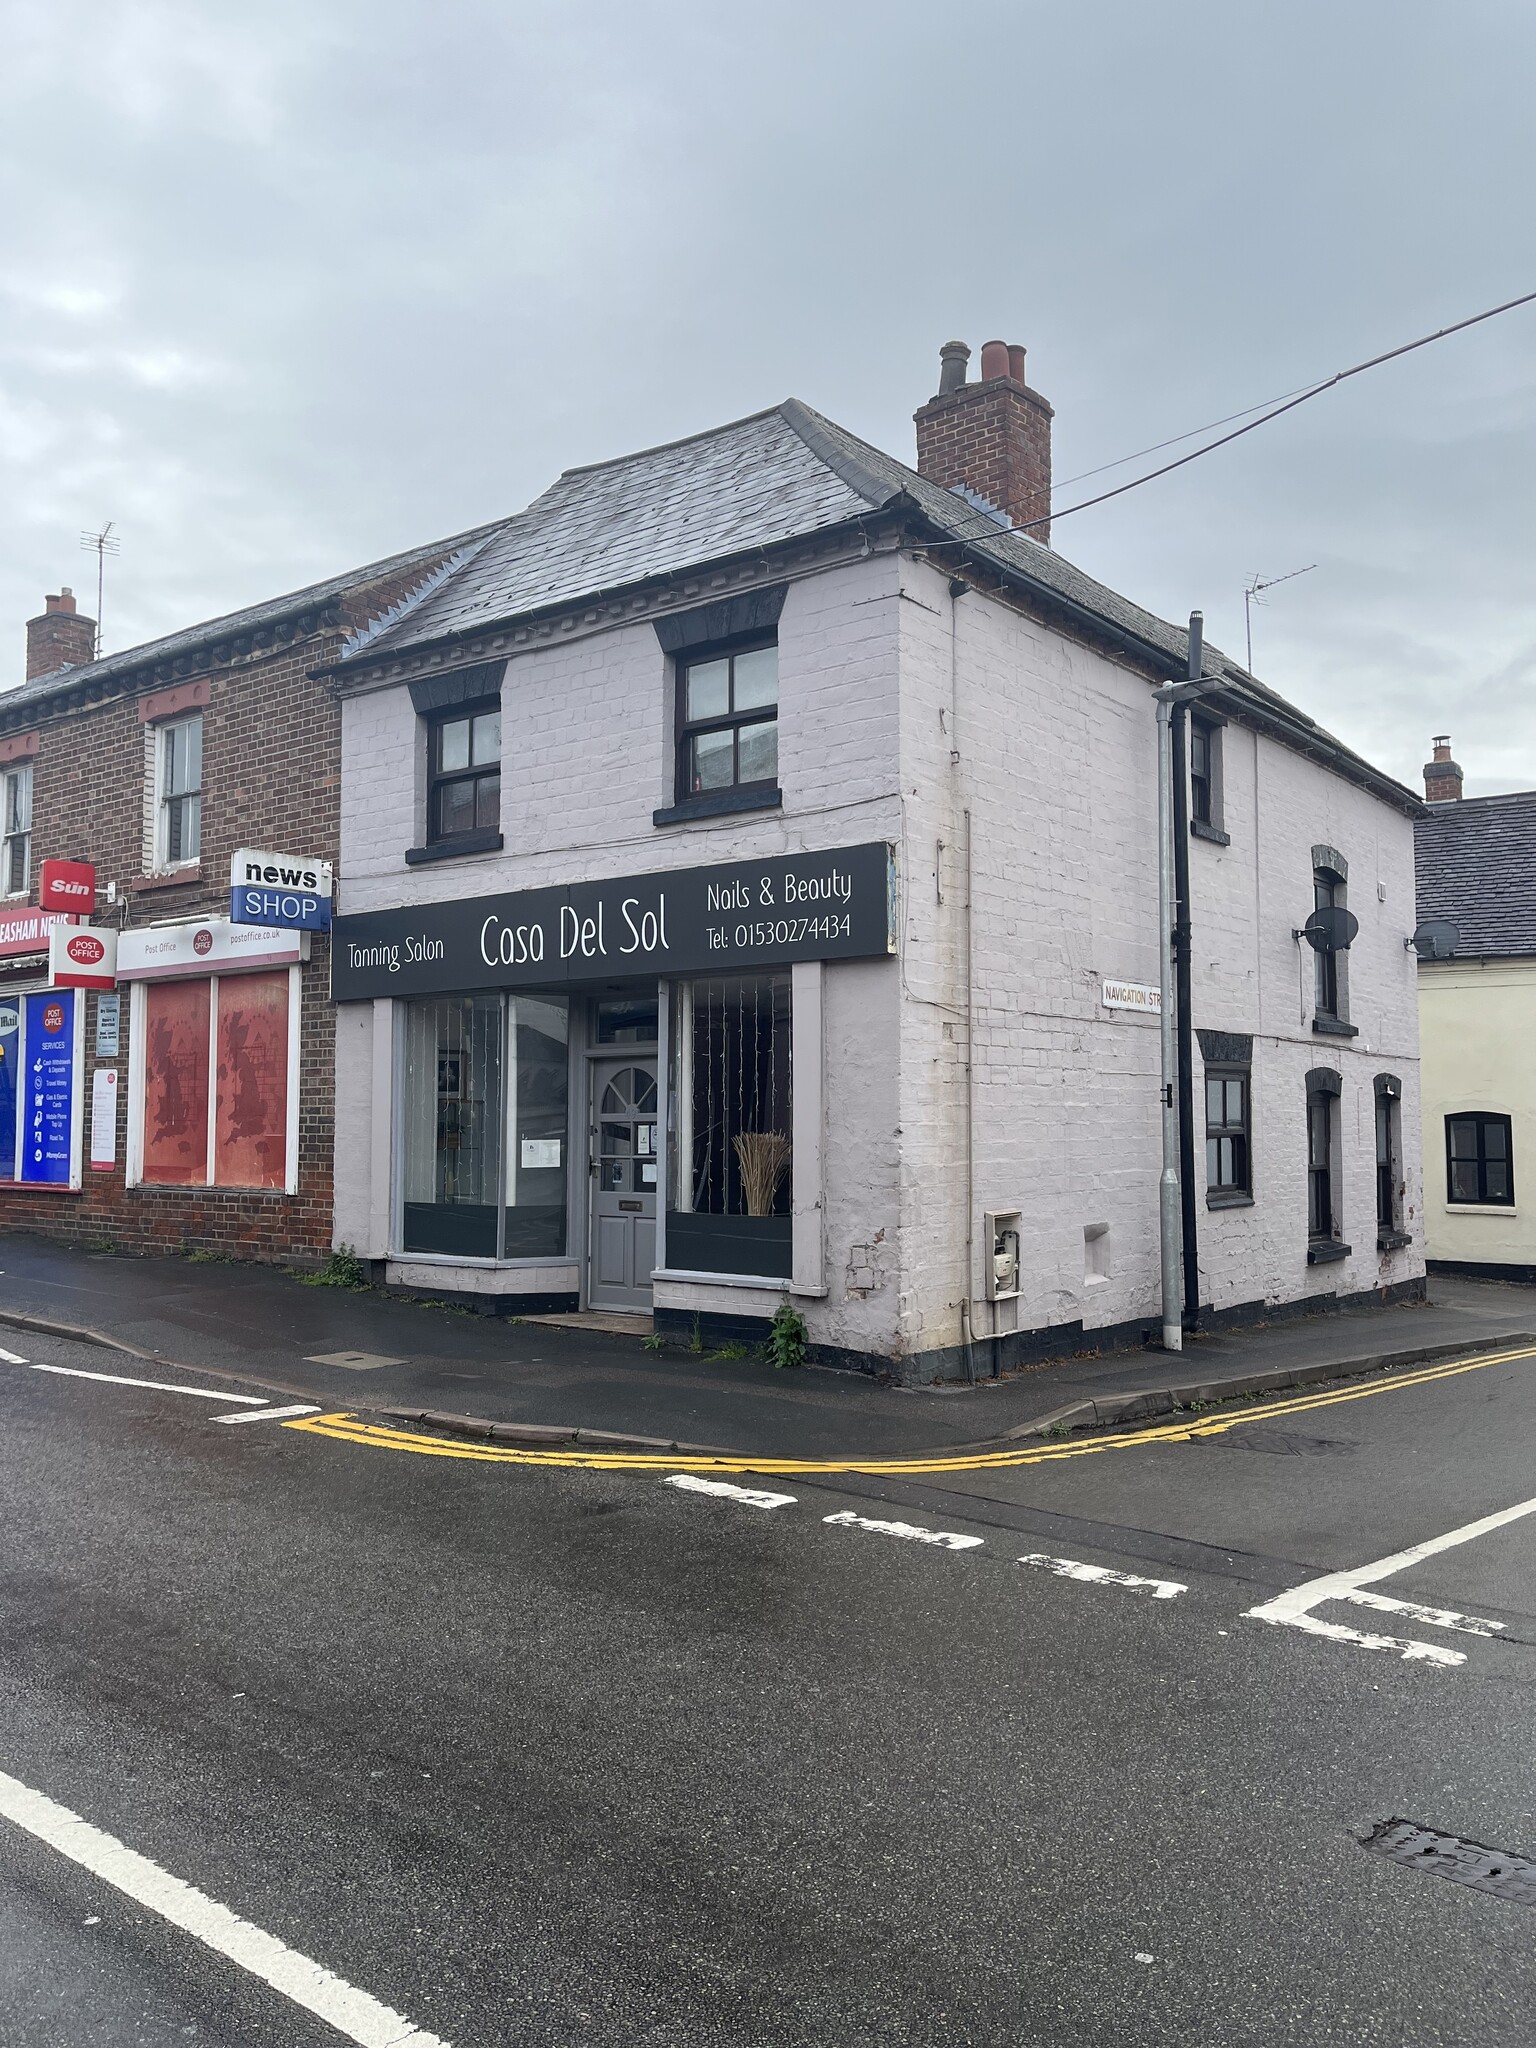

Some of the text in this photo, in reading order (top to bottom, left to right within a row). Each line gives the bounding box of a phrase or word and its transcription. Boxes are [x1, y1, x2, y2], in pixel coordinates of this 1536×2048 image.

[246, 863, 317, 889] news
[50, 879, 90, 895] Sun
[707, 868, 852, 913] Nails & Beauty
[245, 892, 317, 920] SHOP
[0, 918, 38, 944] EASHAM
[230, 928, 280, 945] postoffice.co.uk
[481, 892, 670, 967] Casa Del Sol
[705, 914, 850, 950] Tel: 01530274434
[75, 940, 98, 949] POST
[195, 941, 211, 950] OFFICE
[197, 934, 210, 942] POST
[70, 948, 100, 958] OFFICE
[145, 942, 177, 954] Post Office
[347, 935, 445, 973] Tanning Salon
[1105, 985, 1161, 1006] NAVIGATION STR
[44, 1017, 62, 1026] OFFICE
[47, 1009, 60, 1018] POST
[42, 1042, 65, 1050] SERVICES
